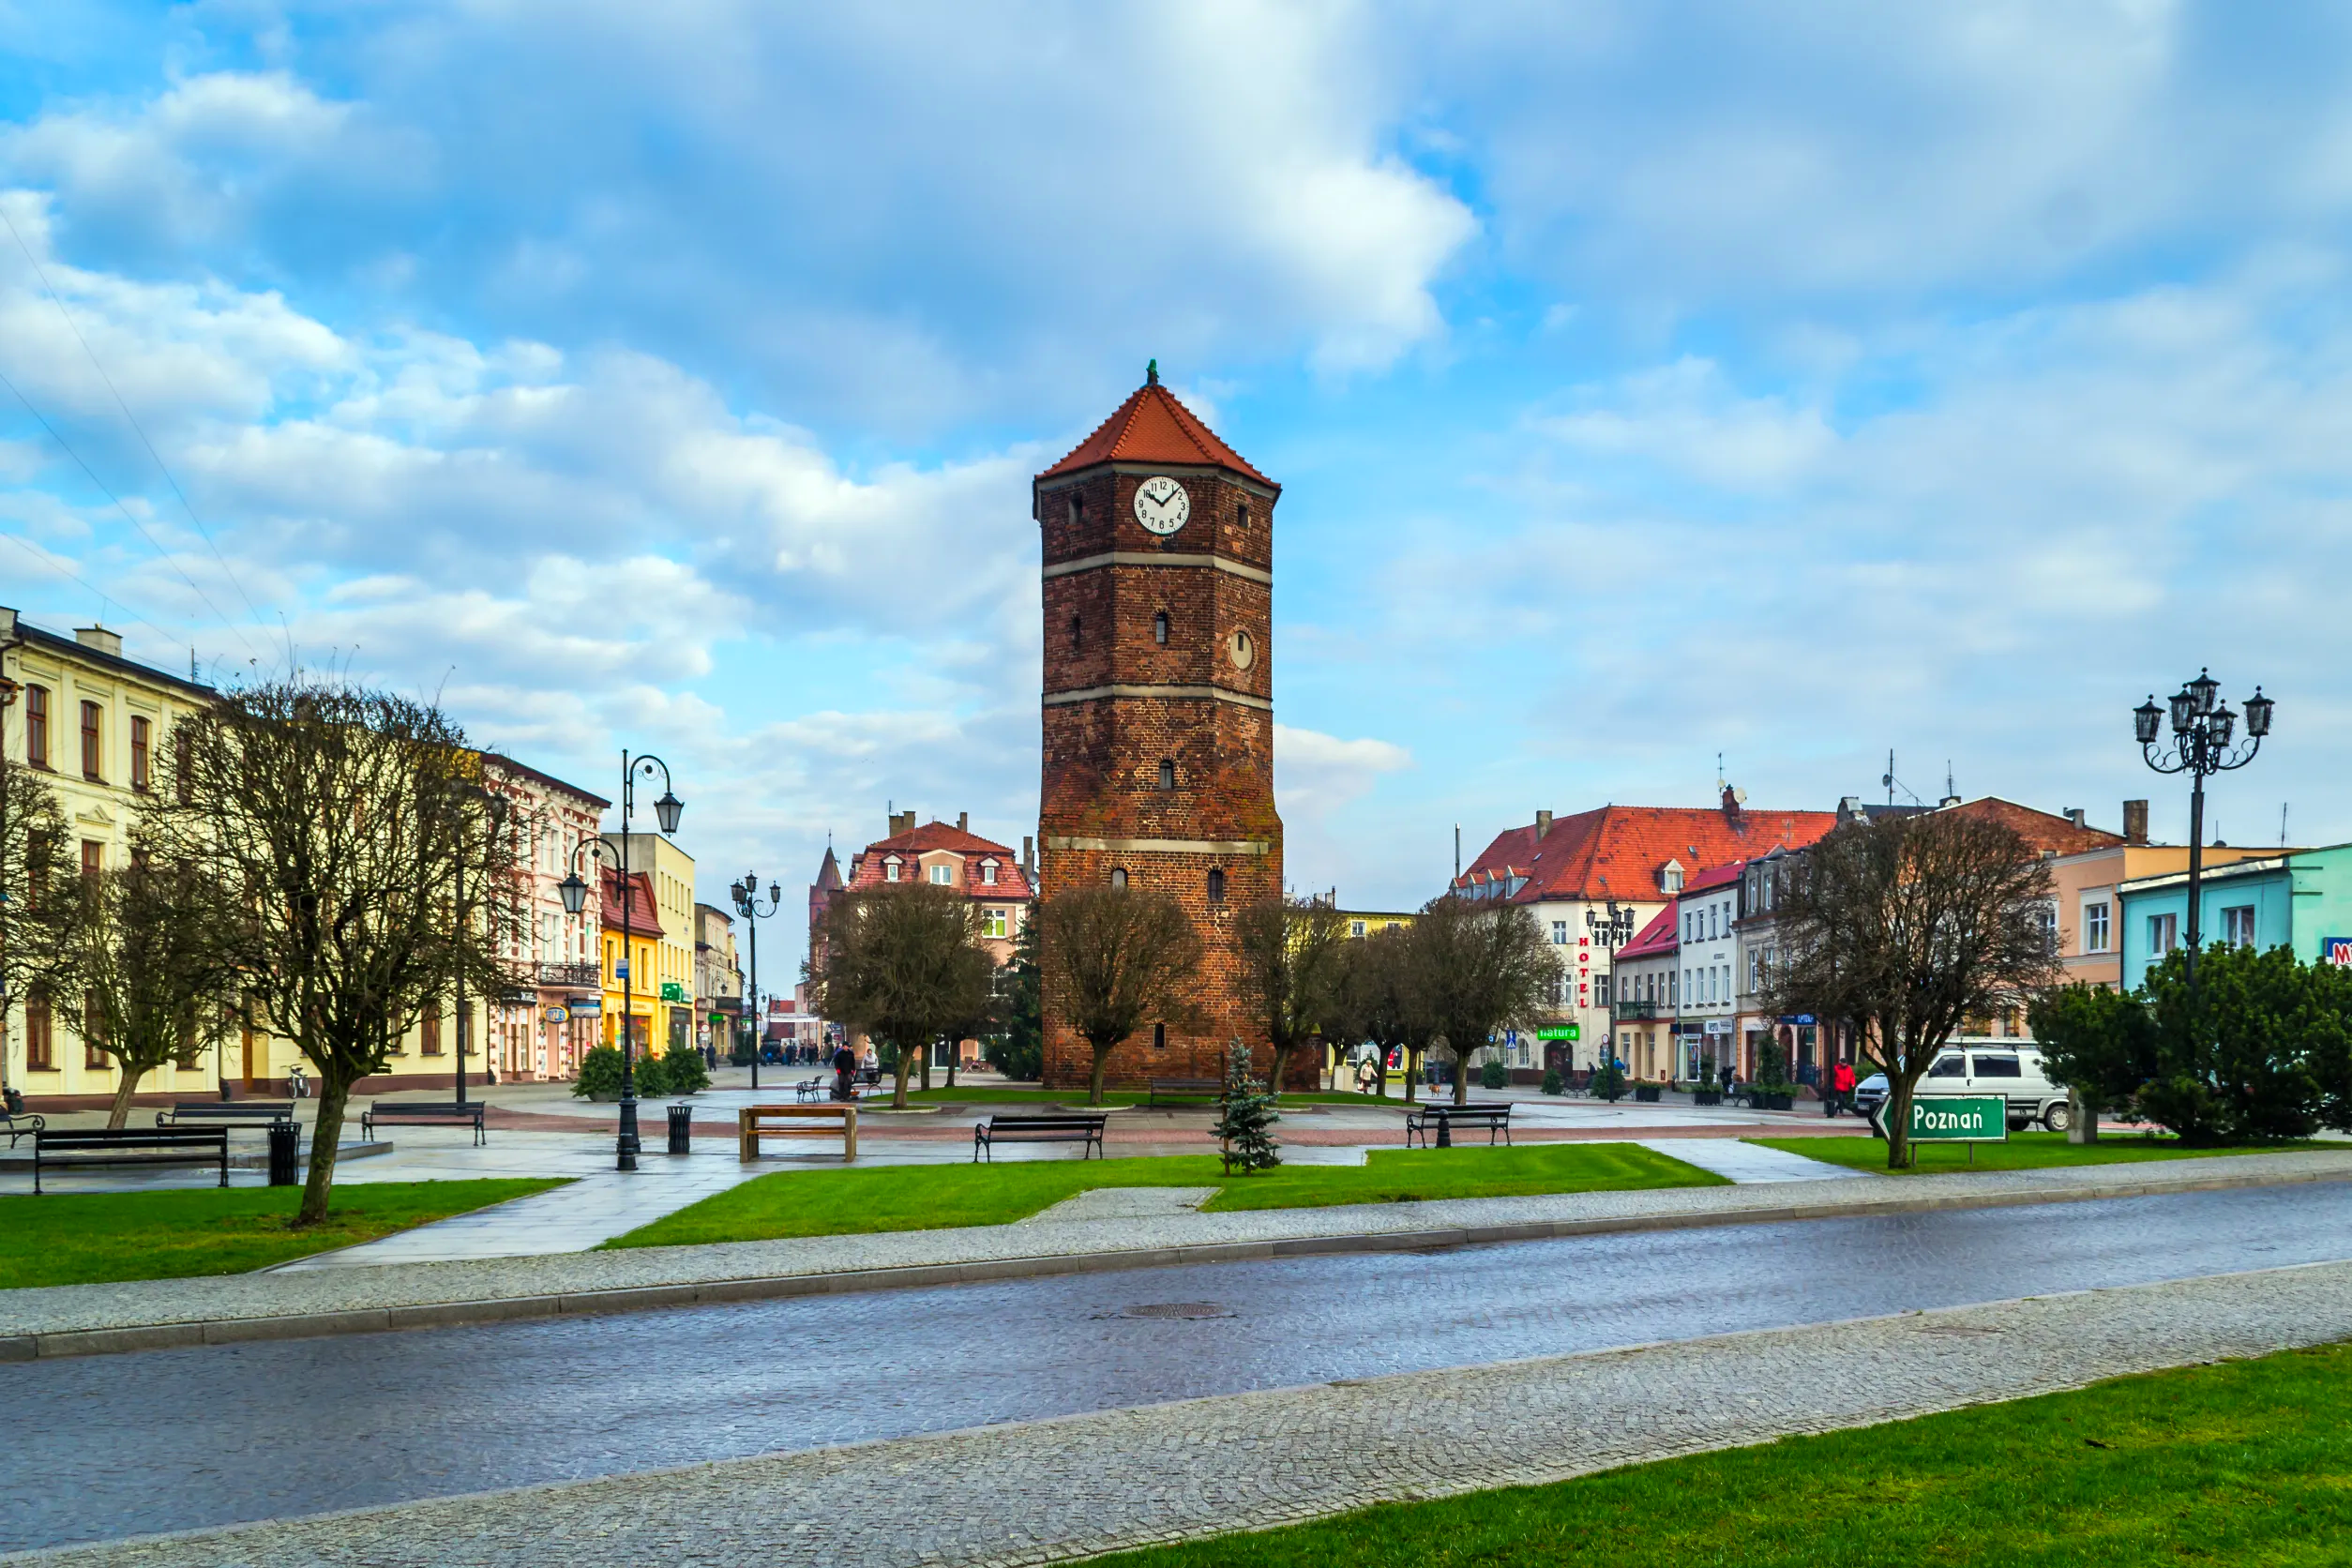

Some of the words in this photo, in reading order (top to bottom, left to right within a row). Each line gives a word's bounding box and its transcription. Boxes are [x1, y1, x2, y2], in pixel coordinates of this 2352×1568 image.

[1152, 483, 1156, 491] 11
[1160, 481, 1167, 490] 12
[1143, 490, 1150, 498] 10
[1178, 491, 1183, 500] 2
[1138, 500, 1143, 508] 9
[1181, 502, 1185, 510] 3
[1142, 509, 1147, 519] 8
[1177, 512, 1182, 520] 4
[1150, 517, 1154, 526] 7
[1159, 520, 1164, 529] 6
[1169, 519, 1174, 527] 5
[1578, 938, 1589, 1008] HOTEL
[1540, 1028, 1576, 1037] natura
[1913, 1105, 1982, 1129] Poznań
